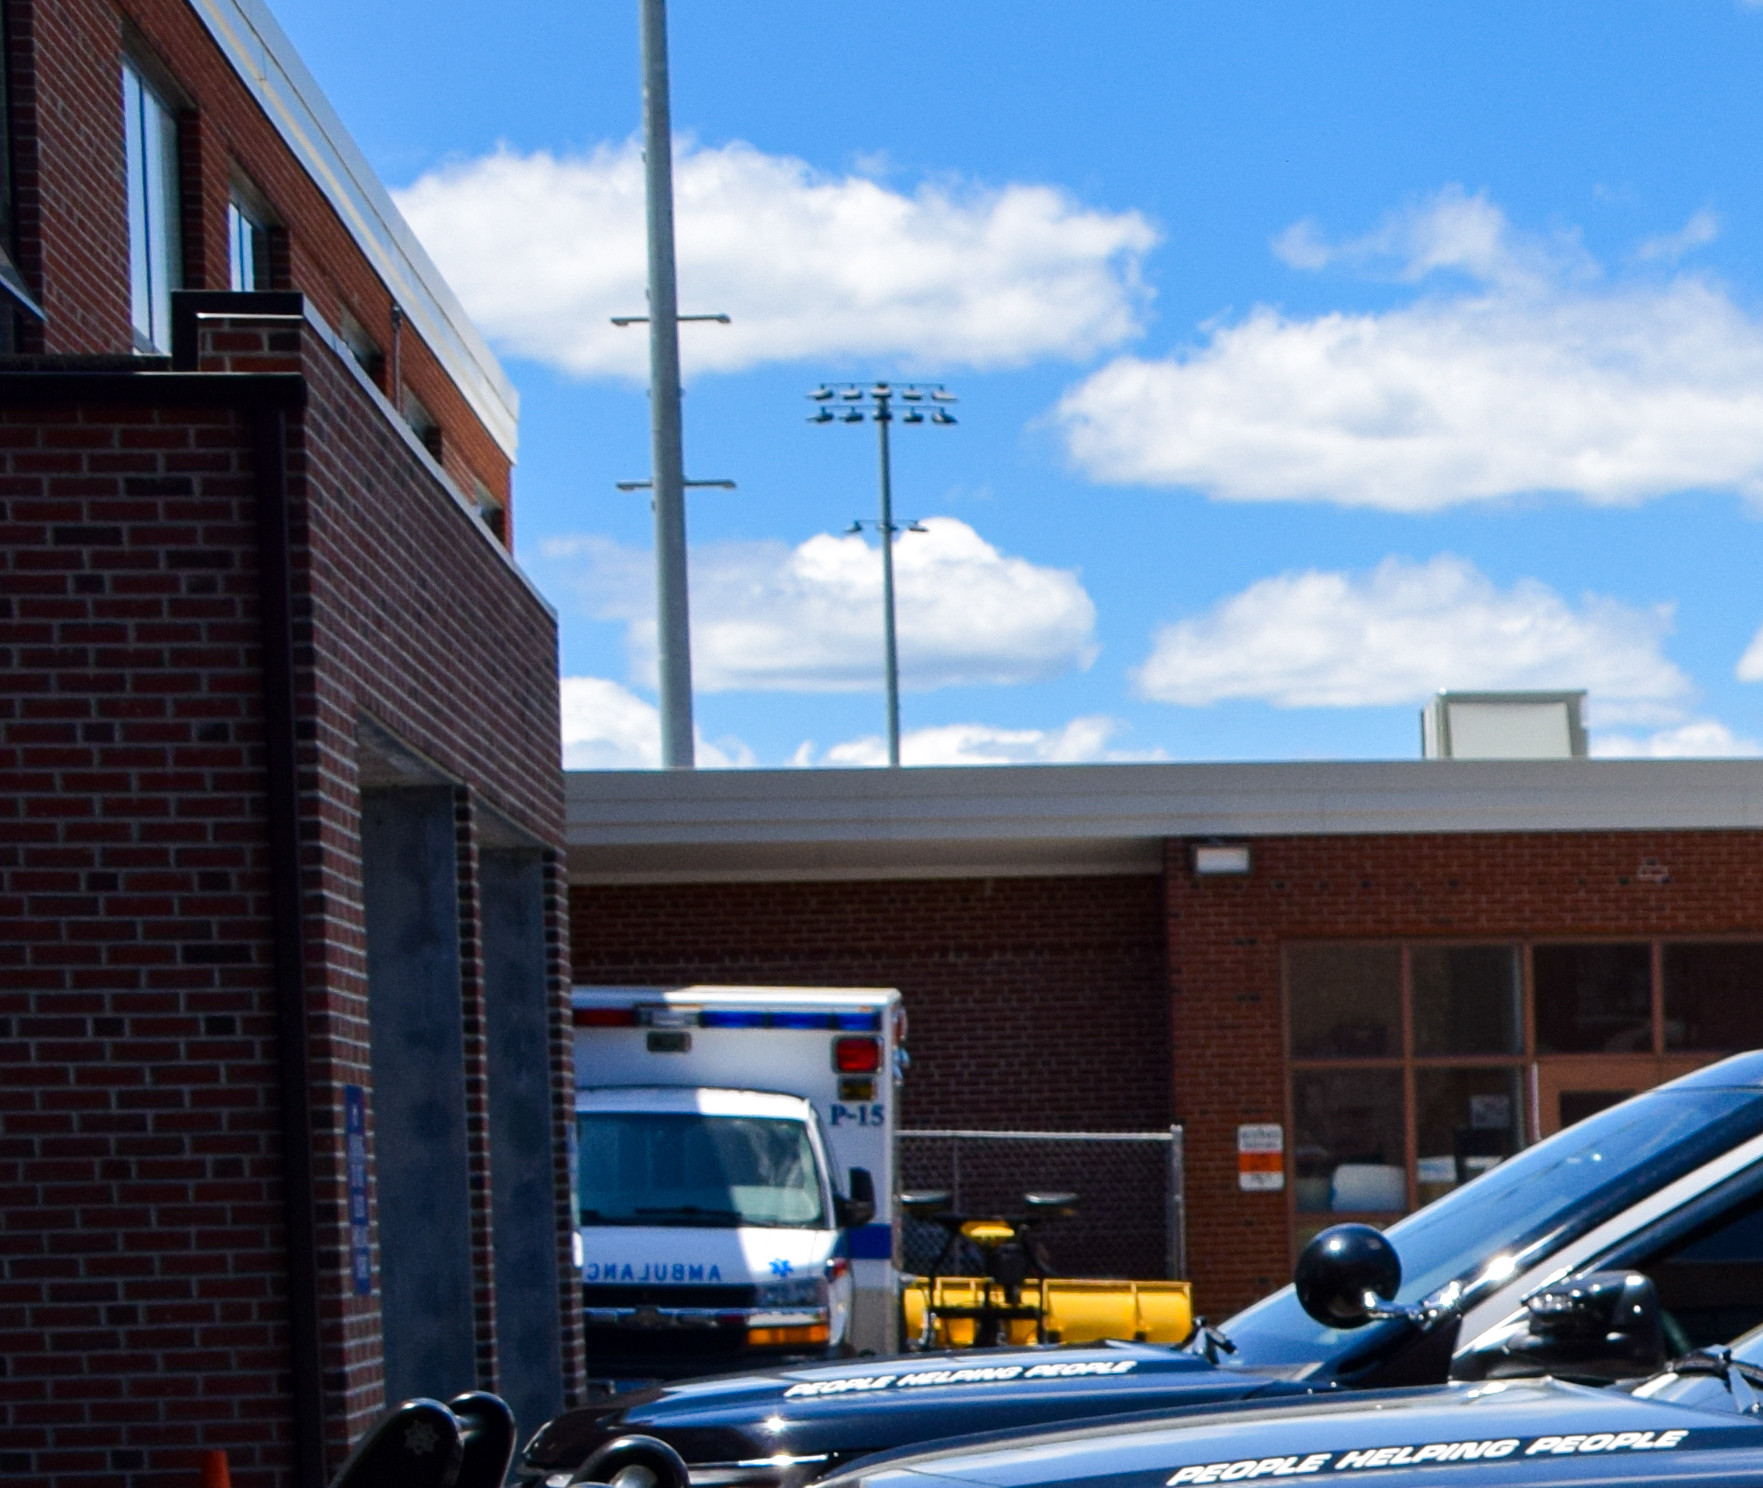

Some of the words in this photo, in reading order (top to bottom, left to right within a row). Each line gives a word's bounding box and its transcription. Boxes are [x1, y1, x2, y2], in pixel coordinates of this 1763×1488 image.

[784, 1375, 896, 1397] PEOPLE
[897, 1366, 1022, 1386] HELPING
[1025, 1361, 1137, 1377] PEOPLE
[1166, 1453, 1332, 1487] PEOPLE
[1335, 1439, 1520, 1470] HELPING
[1526, 1430, 1688, 1456] PEOPLE
